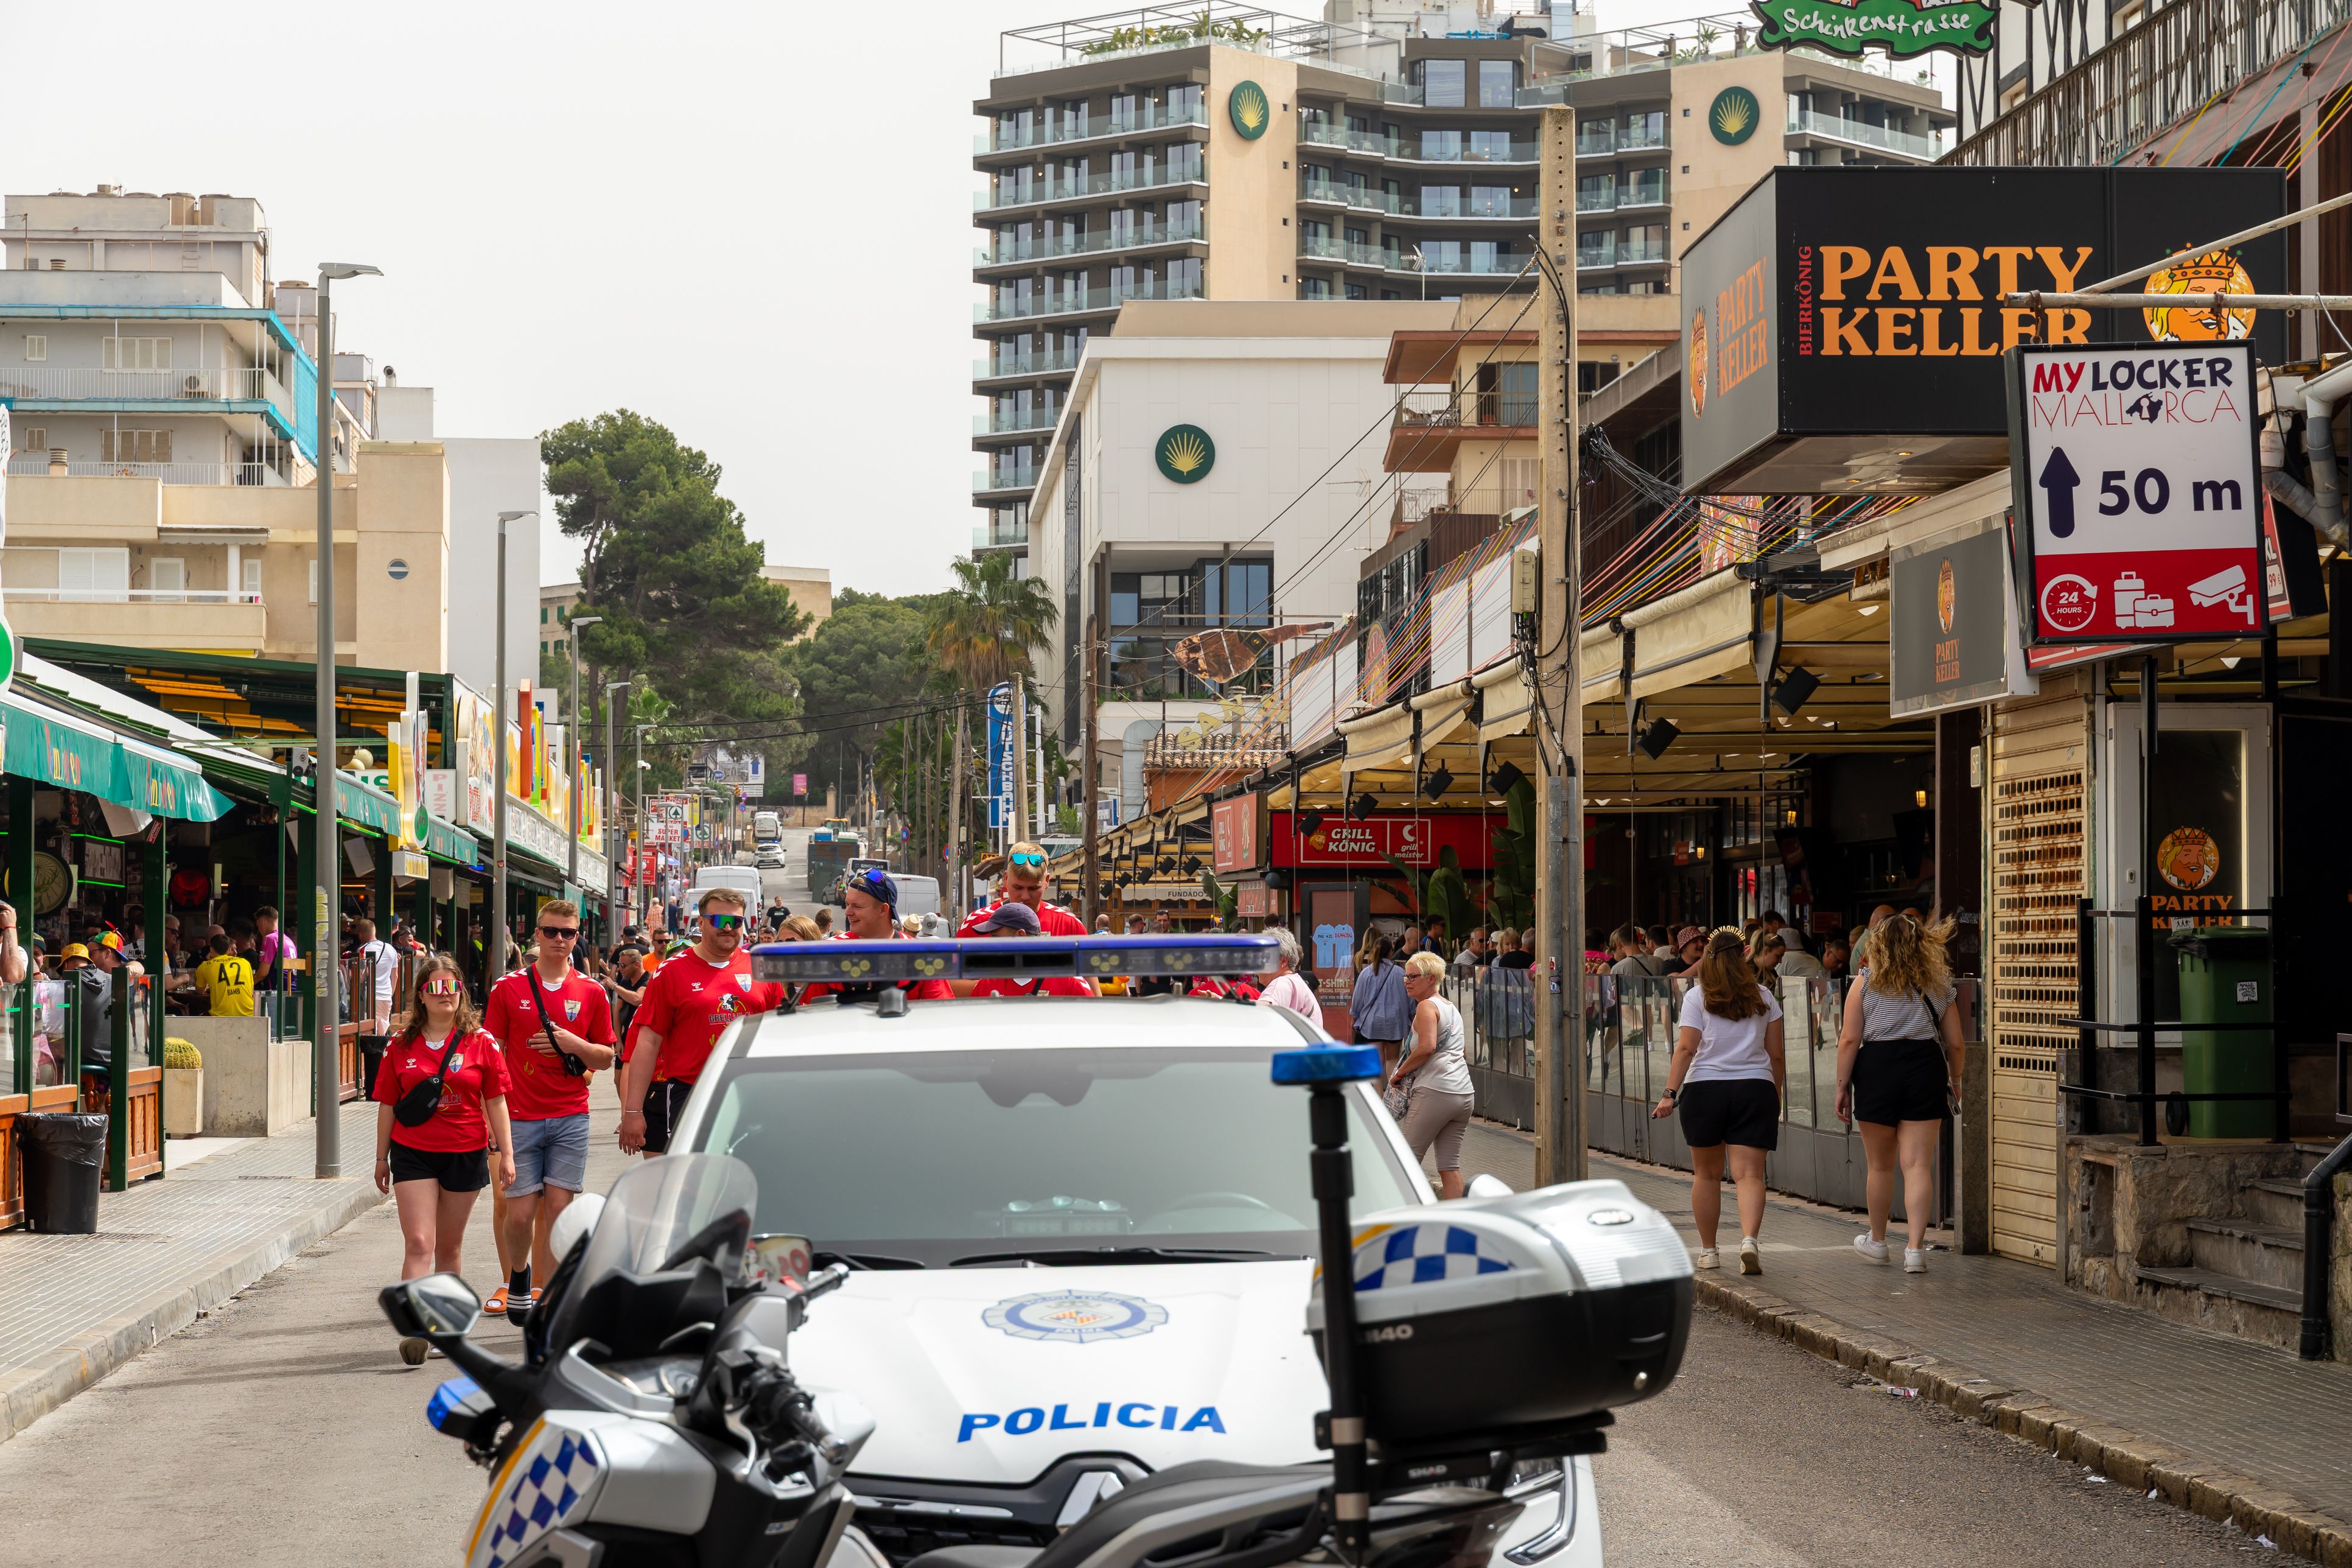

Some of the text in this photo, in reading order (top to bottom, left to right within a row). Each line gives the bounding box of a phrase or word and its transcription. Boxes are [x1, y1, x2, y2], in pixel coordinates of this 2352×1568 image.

[1783, 8, 1972, 40] Schinkenstrasse
[1819, 246, 2093, 301] PARTY
[1720, 255, 1767, 344] PARTY
[1794, 245, 1813, 356] BIERKÖNIG
[1819, 307, 2093, 356] KELLER
[1720, 318, 1768, 396] KELLER
[2032, 357, 2233, 393] MY LOCKER
[2098, 467, 2242, 516] 50 m
[2056, 606, 2082, 614] HOURS
[2059, 591, 2079, 604] 24
[1935, 639, 1959, 663] PARTY
[1935, 661, 1960, 683] KELLER
[1001, 721, 1015, 822] RUTSCHBAHN
[432, 773, 448, 816] PIZZ
[1328, 839, 1376, 853] KÖNIG
[1331, 827, 1373, 839] GRILL
[1401, 843, 1418, 852] grill
[2152, 895, 2233, 911] PARTY
[2152, 916, 2233, 929] KLER
[218, 962, 245, 987] 42
[1318, 978, 1349, 988] T-SHIRT
[957, 1402, 1227, 1443] POLICIA
